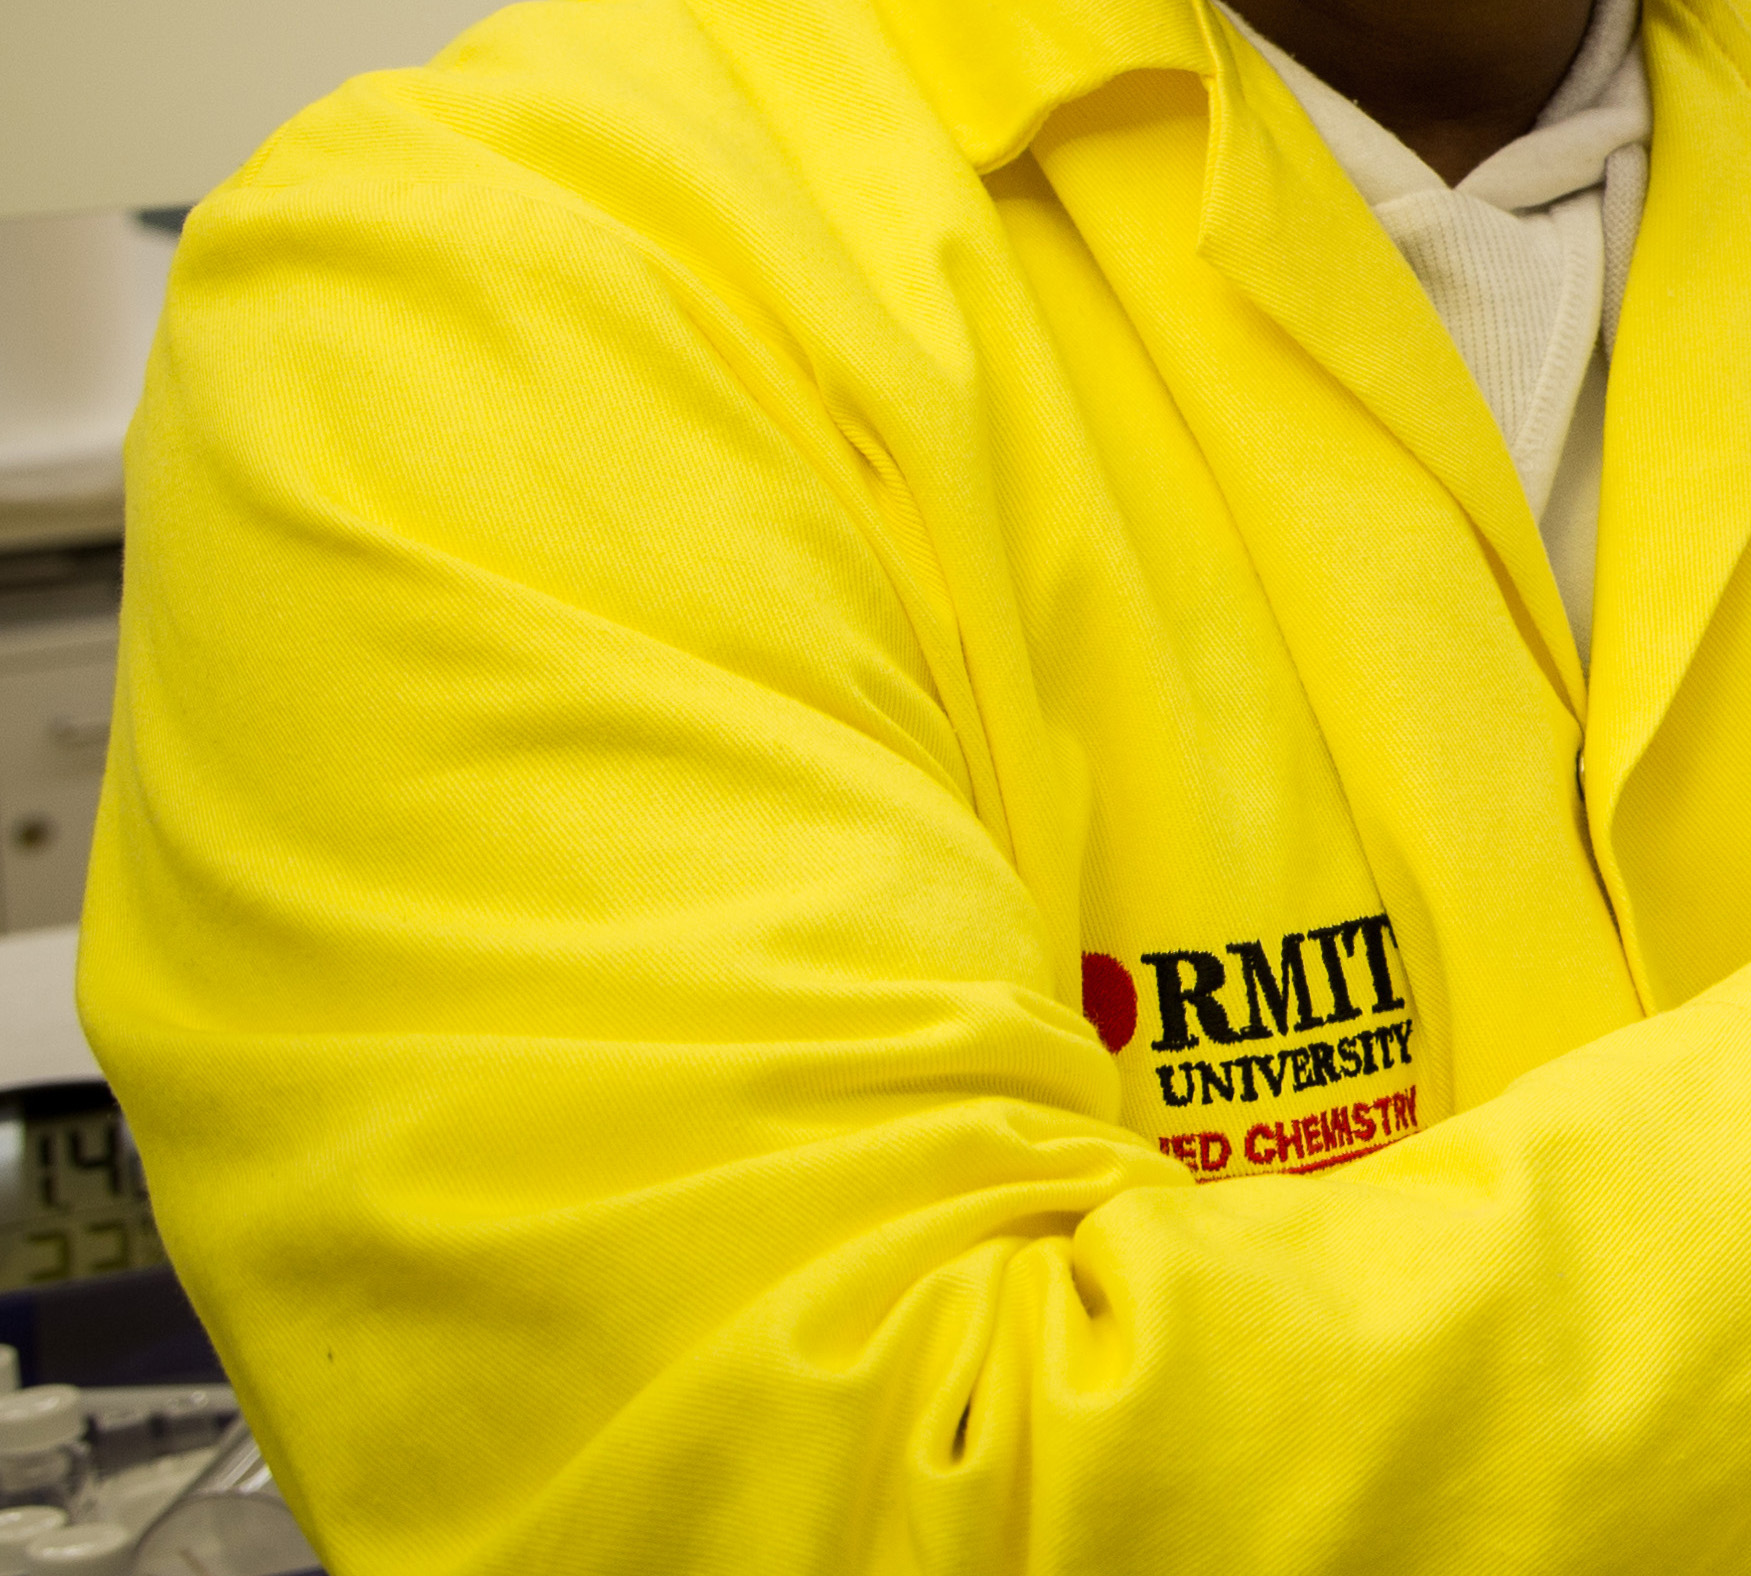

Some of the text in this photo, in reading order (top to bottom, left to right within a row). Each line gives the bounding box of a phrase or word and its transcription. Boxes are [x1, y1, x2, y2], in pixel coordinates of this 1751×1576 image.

[1141, 913, 1404, 1052] RMIT
[1155, 1020, 1413, 1107] UNIVERSITY
[1244, 1085, 1417, 1165] CHEMISTRY
